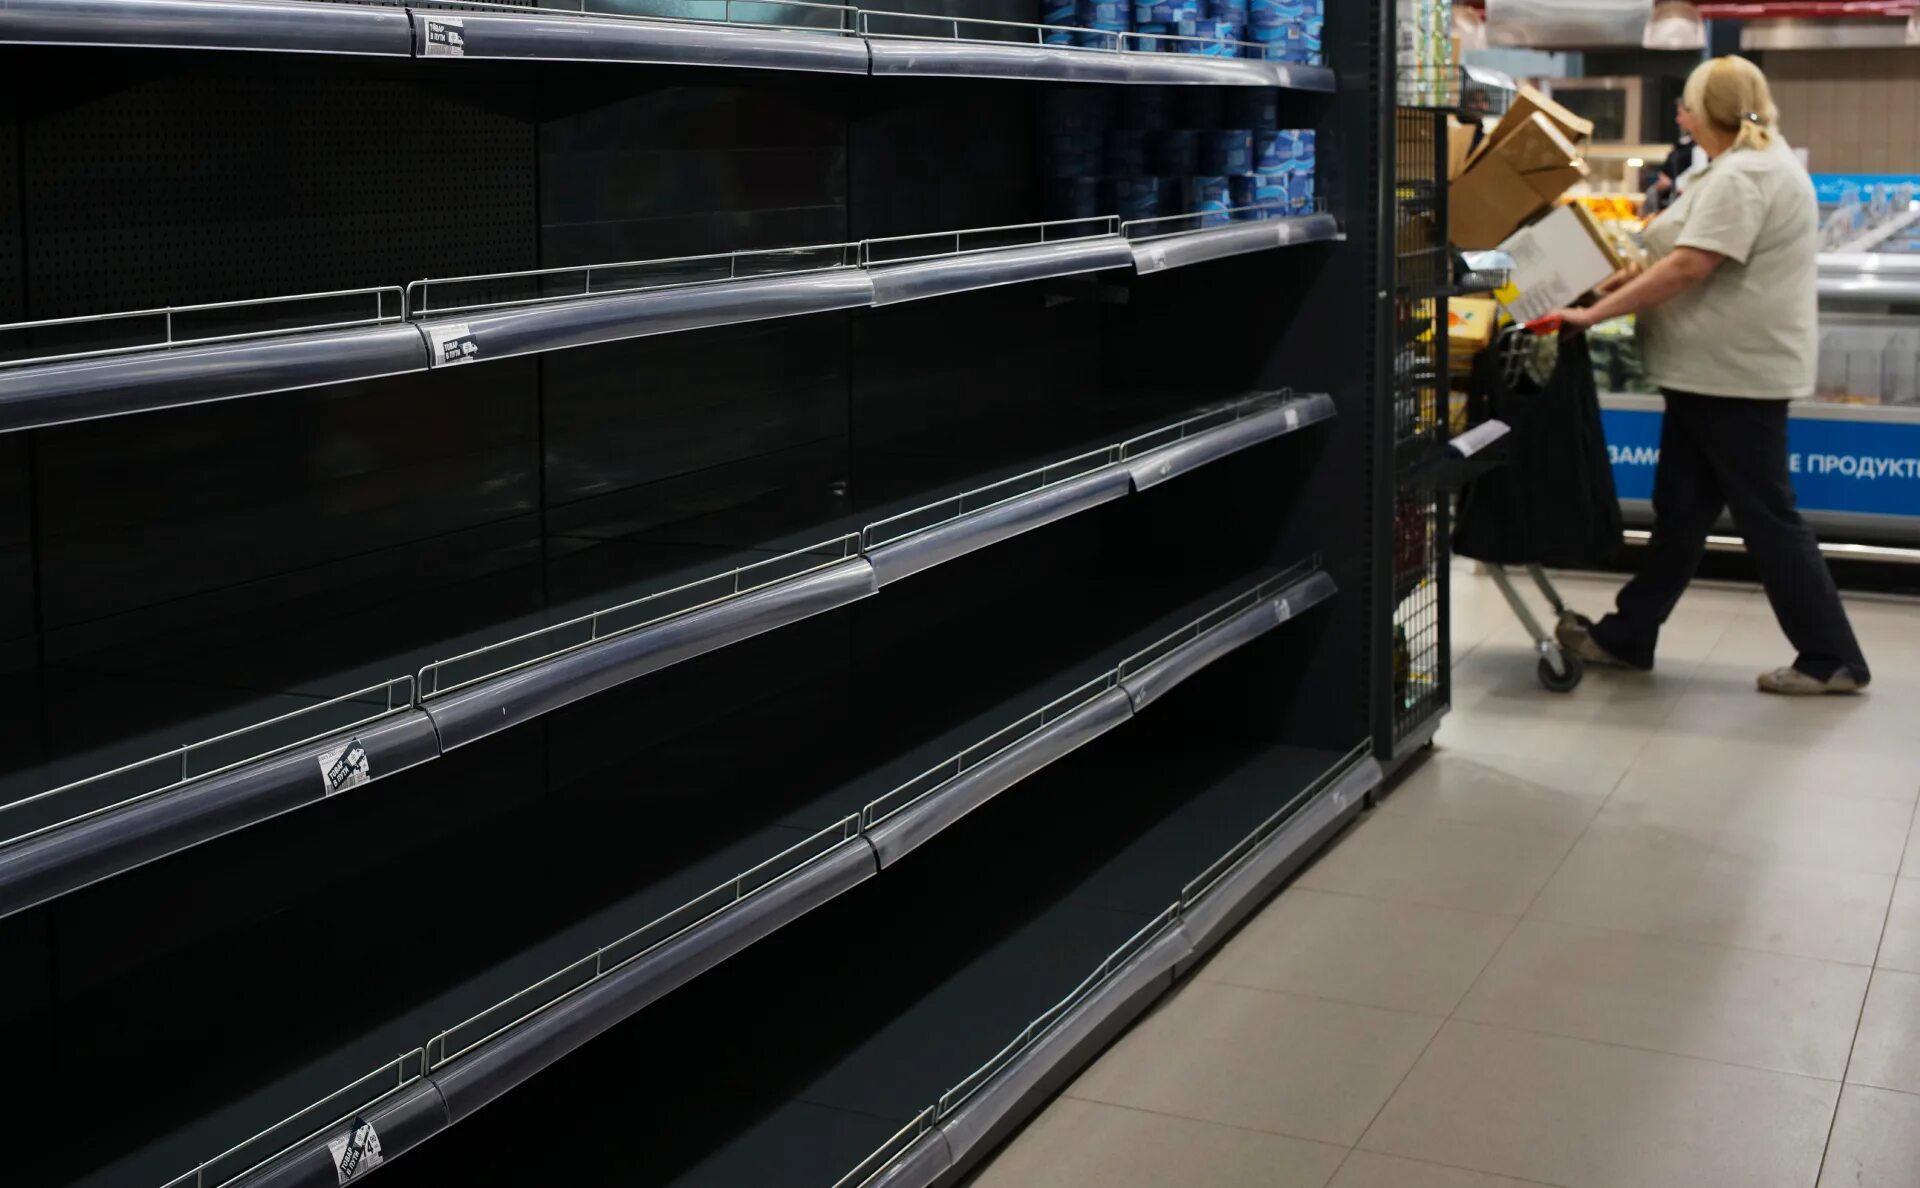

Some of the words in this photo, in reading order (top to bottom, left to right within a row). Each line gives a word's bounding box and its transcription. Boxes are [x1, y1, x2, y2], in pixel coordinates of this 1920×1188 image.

[329, 760, 344, 780] ТОВАР
[336, 766, 350, 784] ПУТИ
[341, 1147, 353, 1170] ТОВАР
[349, 1150, 360, 1168] ПУТИ
